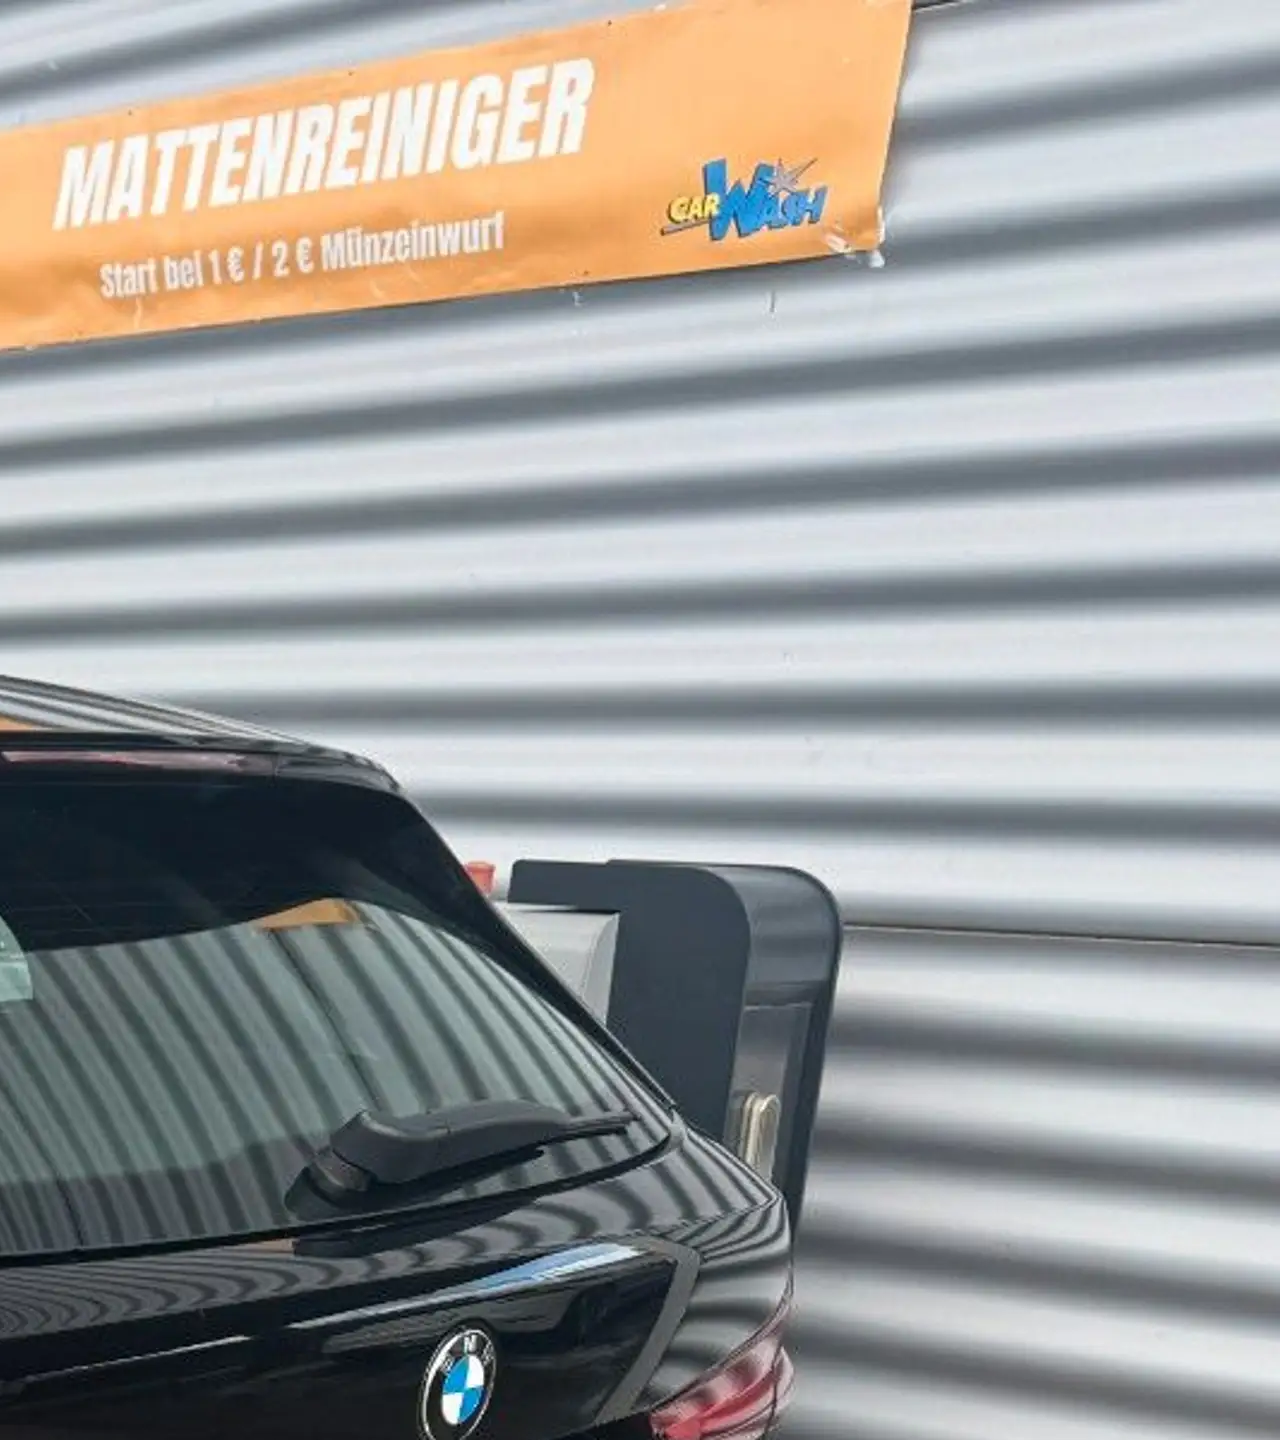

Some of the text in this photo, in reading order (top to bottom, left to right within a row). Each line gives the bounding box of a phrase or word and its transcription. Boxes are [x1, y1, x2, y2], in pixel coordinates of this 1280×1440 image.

[52, 58, 596, 230] MATTENREINIGER
[668, 193, 721, 223] CAR
[99, 211, 505, 298] Start bei 1 € / 2 € Münzeinwurf
